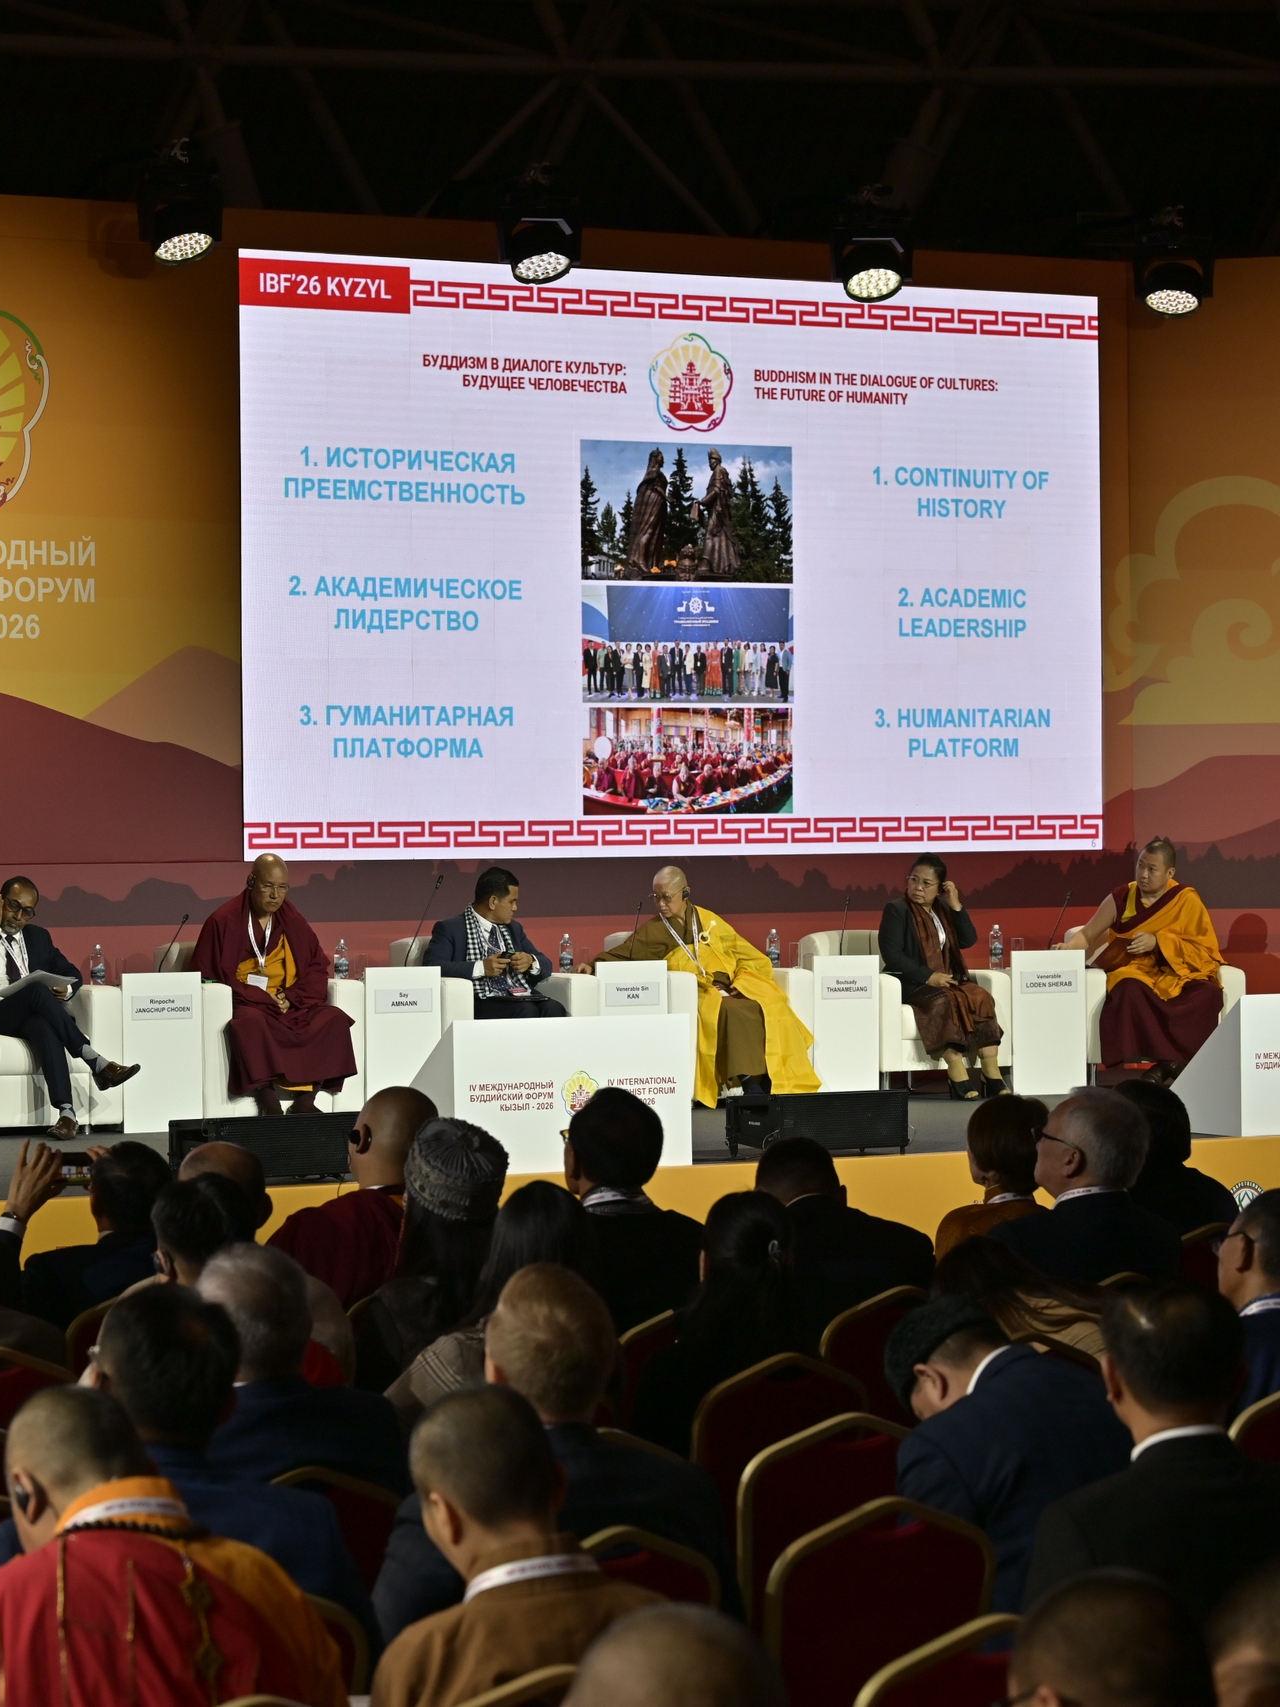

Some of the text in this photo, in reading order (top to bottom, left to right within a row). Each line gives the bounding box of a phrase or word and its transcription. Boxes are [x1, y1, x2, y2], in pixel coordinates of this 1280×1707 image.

[327, 277, 391, 299] KYZYL
[423, 354, 627, 376] БУДДИЗМ В ДИАЛОГЕ КУЛЬТУР:
[463, 375, 627, 393] БУДУЩЕЕ ЧЕЛОВЕЧЕСТВА
[755, 370, 997, 391] BUDDHISM IN THE DIALOGUE OF CULTURES:
[754, 387, 907, 405] THE FUTURE OF HUMANITY
[301, 446, 515, 473] 1. ИСТОРИЧЕСКАЯ
[873, 466, 1049, 490] 1. CONTINUITY OF
[285, 478, 525, 505] ПРЕЕМСТВЕННОСТЬ
[918, 498, 1006, 518] HISTORY
[289, 576, 522, 601] 2. АКАДЕМИЧЕСКОЕ
[899, 588, 1026, 608] 2. ACADEMIC
[334, 609, 478, 633] ЛИДЕРСТВО
[899, 618, 1026, 638] LEADERSHIP
[300, 705, 513, 726] 3. ГУМАНИТАРНАЯ
[875, 709, 1050, 728] 3. HUMANITARIAN
[334, 738, 483, 758] ПЛАТФОРМА
[909, 738, 1018, 757] PLATFORM
[1092, 839, 1096, 848] 6
[478, 1080, 553, 1092] МЕЖДУНАРОДНЫЙ
[617, 1077, 676, 1085] INTERNATIONAL
[648, 1086, 676, 1095] FORUM
[470, 1092, 553, 1103] БУДДИЙСКИЙ ФОРУМ
[500, 1103, 529, 1111] КЫЗЫЛ
[537, 1102, 553, 1110] 2026
